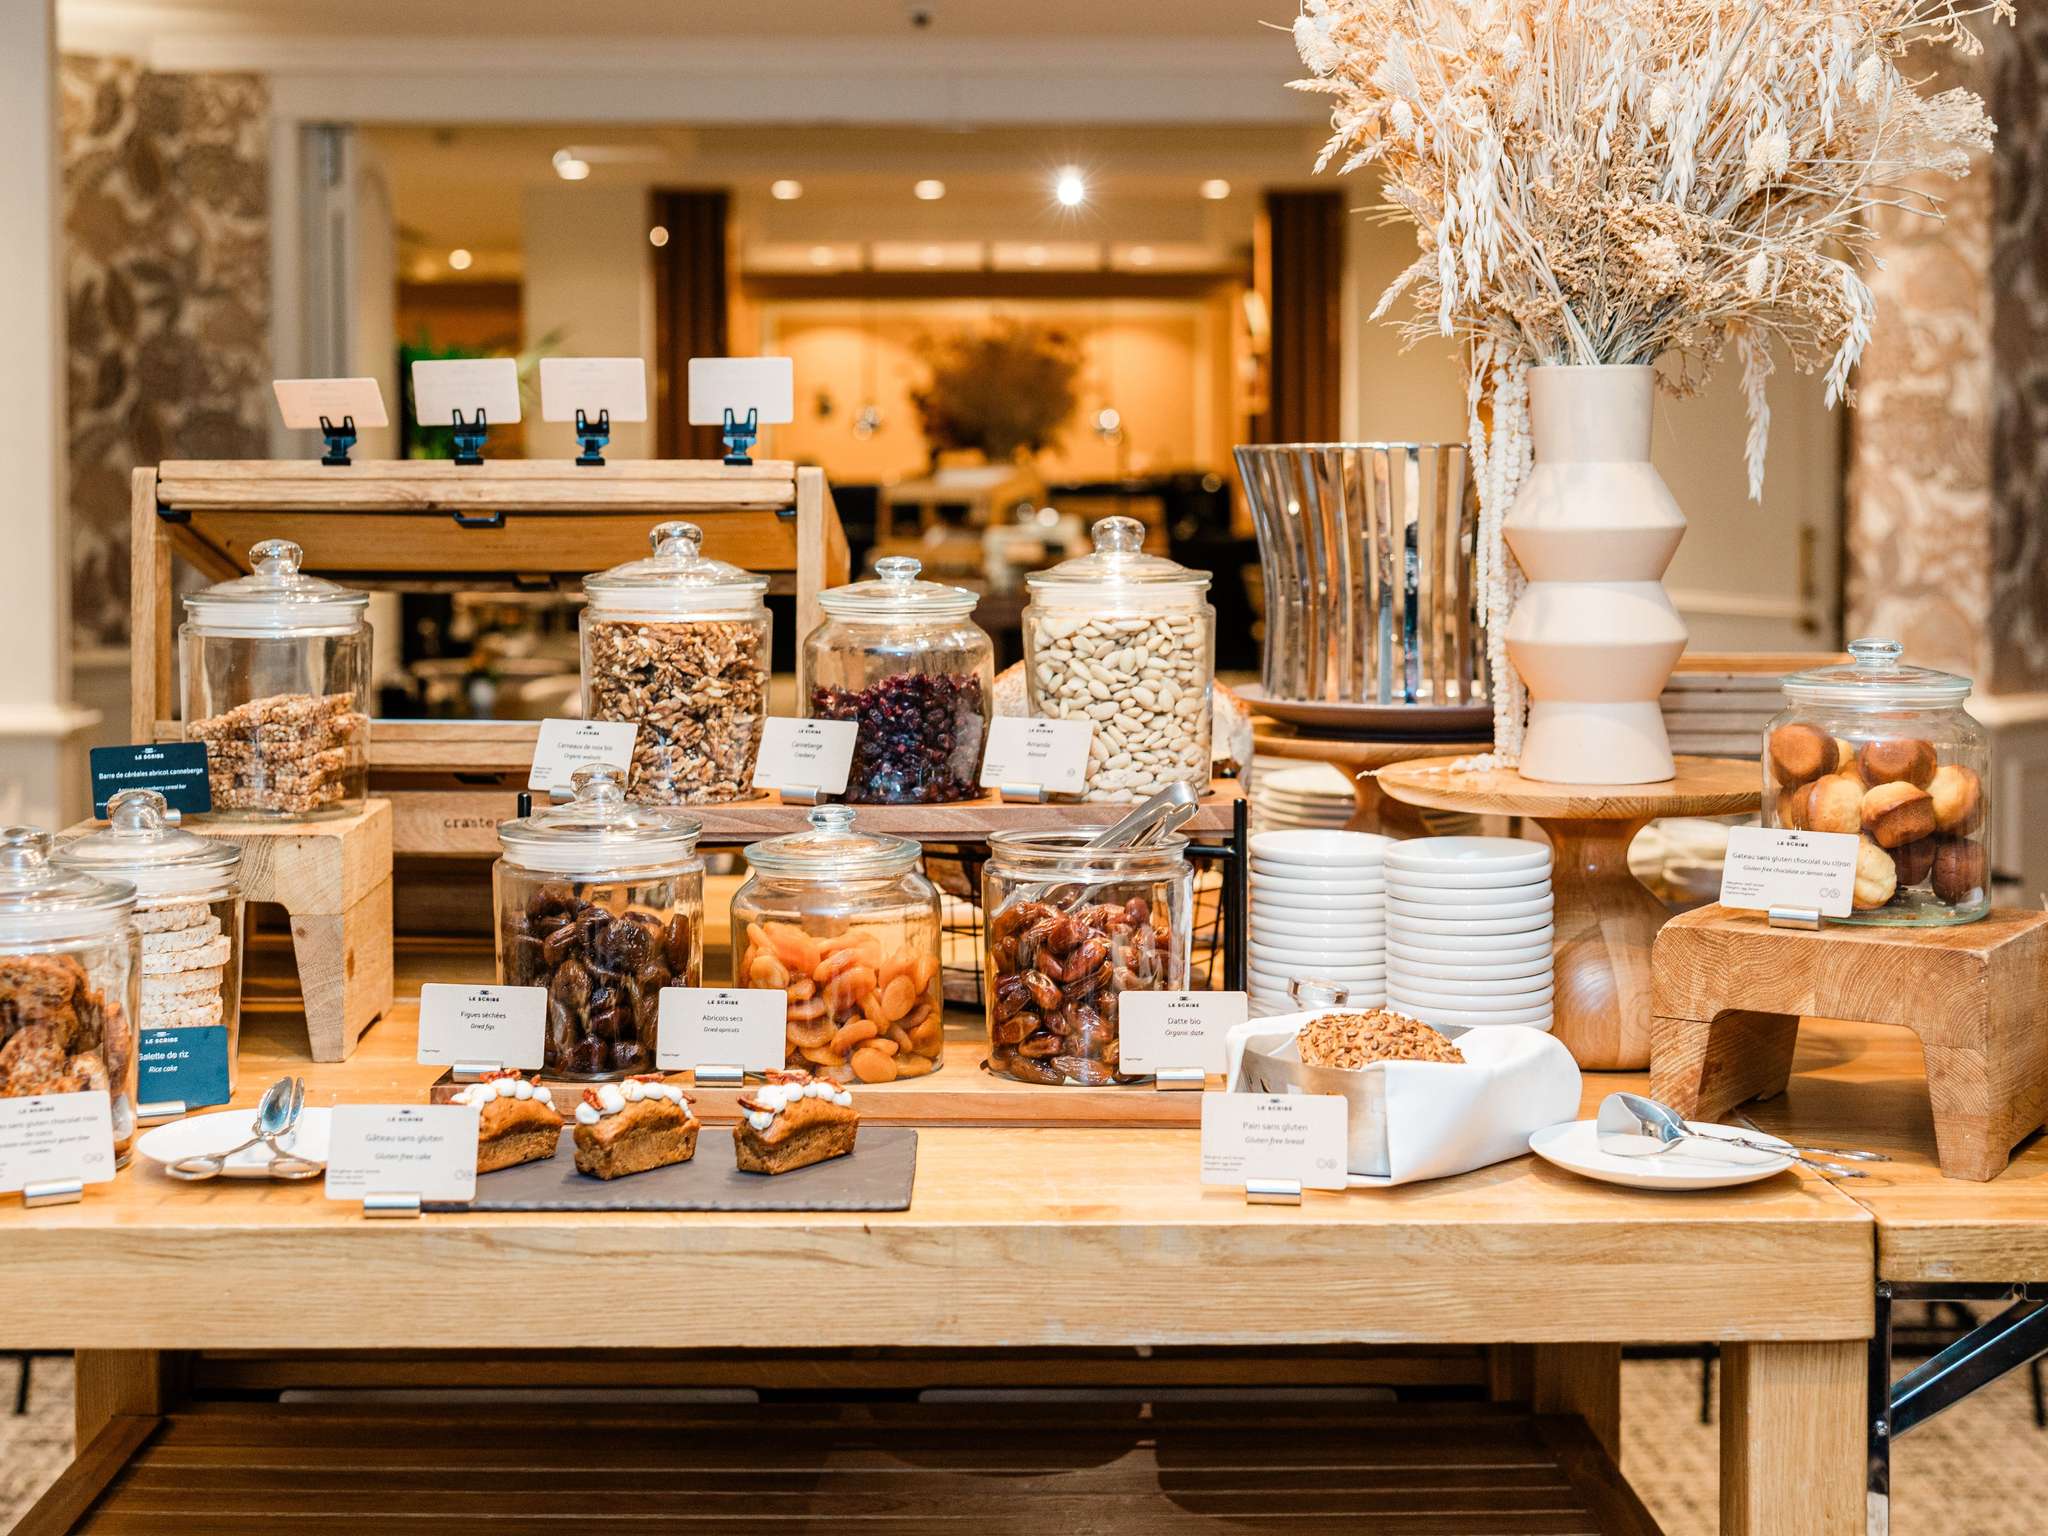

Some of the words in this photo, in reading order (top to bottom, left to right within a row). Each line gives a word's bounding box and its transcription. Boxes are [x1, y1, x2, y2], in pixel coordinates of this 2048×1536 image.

[98, 772, 115, 780] Barre
[124, 769, 148, 778] céréales
[149, 768, 169, 776] abricot
[170, 766, 204, 776] canneberge
[1772, 855, 1792, 864] gluten
[1793, 856, 1820, 866] chocolat
[1832, 860, 1852, 868] citron
[1773, 867, 1800, 875] chocolate
[482, 1011, 506, 1019] séchées
[702, 1014, 729, 1022] Abricots
[1167, 1017, 1188, 1025] Datte
[1189, 1016, 1202, 1025] bio
[1164, 1029, 1188, 1038] Organic
[1190, 1028, 1204, 1036] date
[166, 1051, 178, 1060] de
[178, 1050, 190, 1058] riz
[162, 1064, 178, 1072] cake
[1242, 1121, 1260, 1130] Pain
[1281, 1122, 1308, 1132] gluten
[396, 1134, 414, 1142] sans
[416, 1133, 444, 1144] gluten
[1284, 1136, 1305, 1146] bread
[374, 1152, 398, 1160] Gluten
[399, 1153, 413, 1162] free
